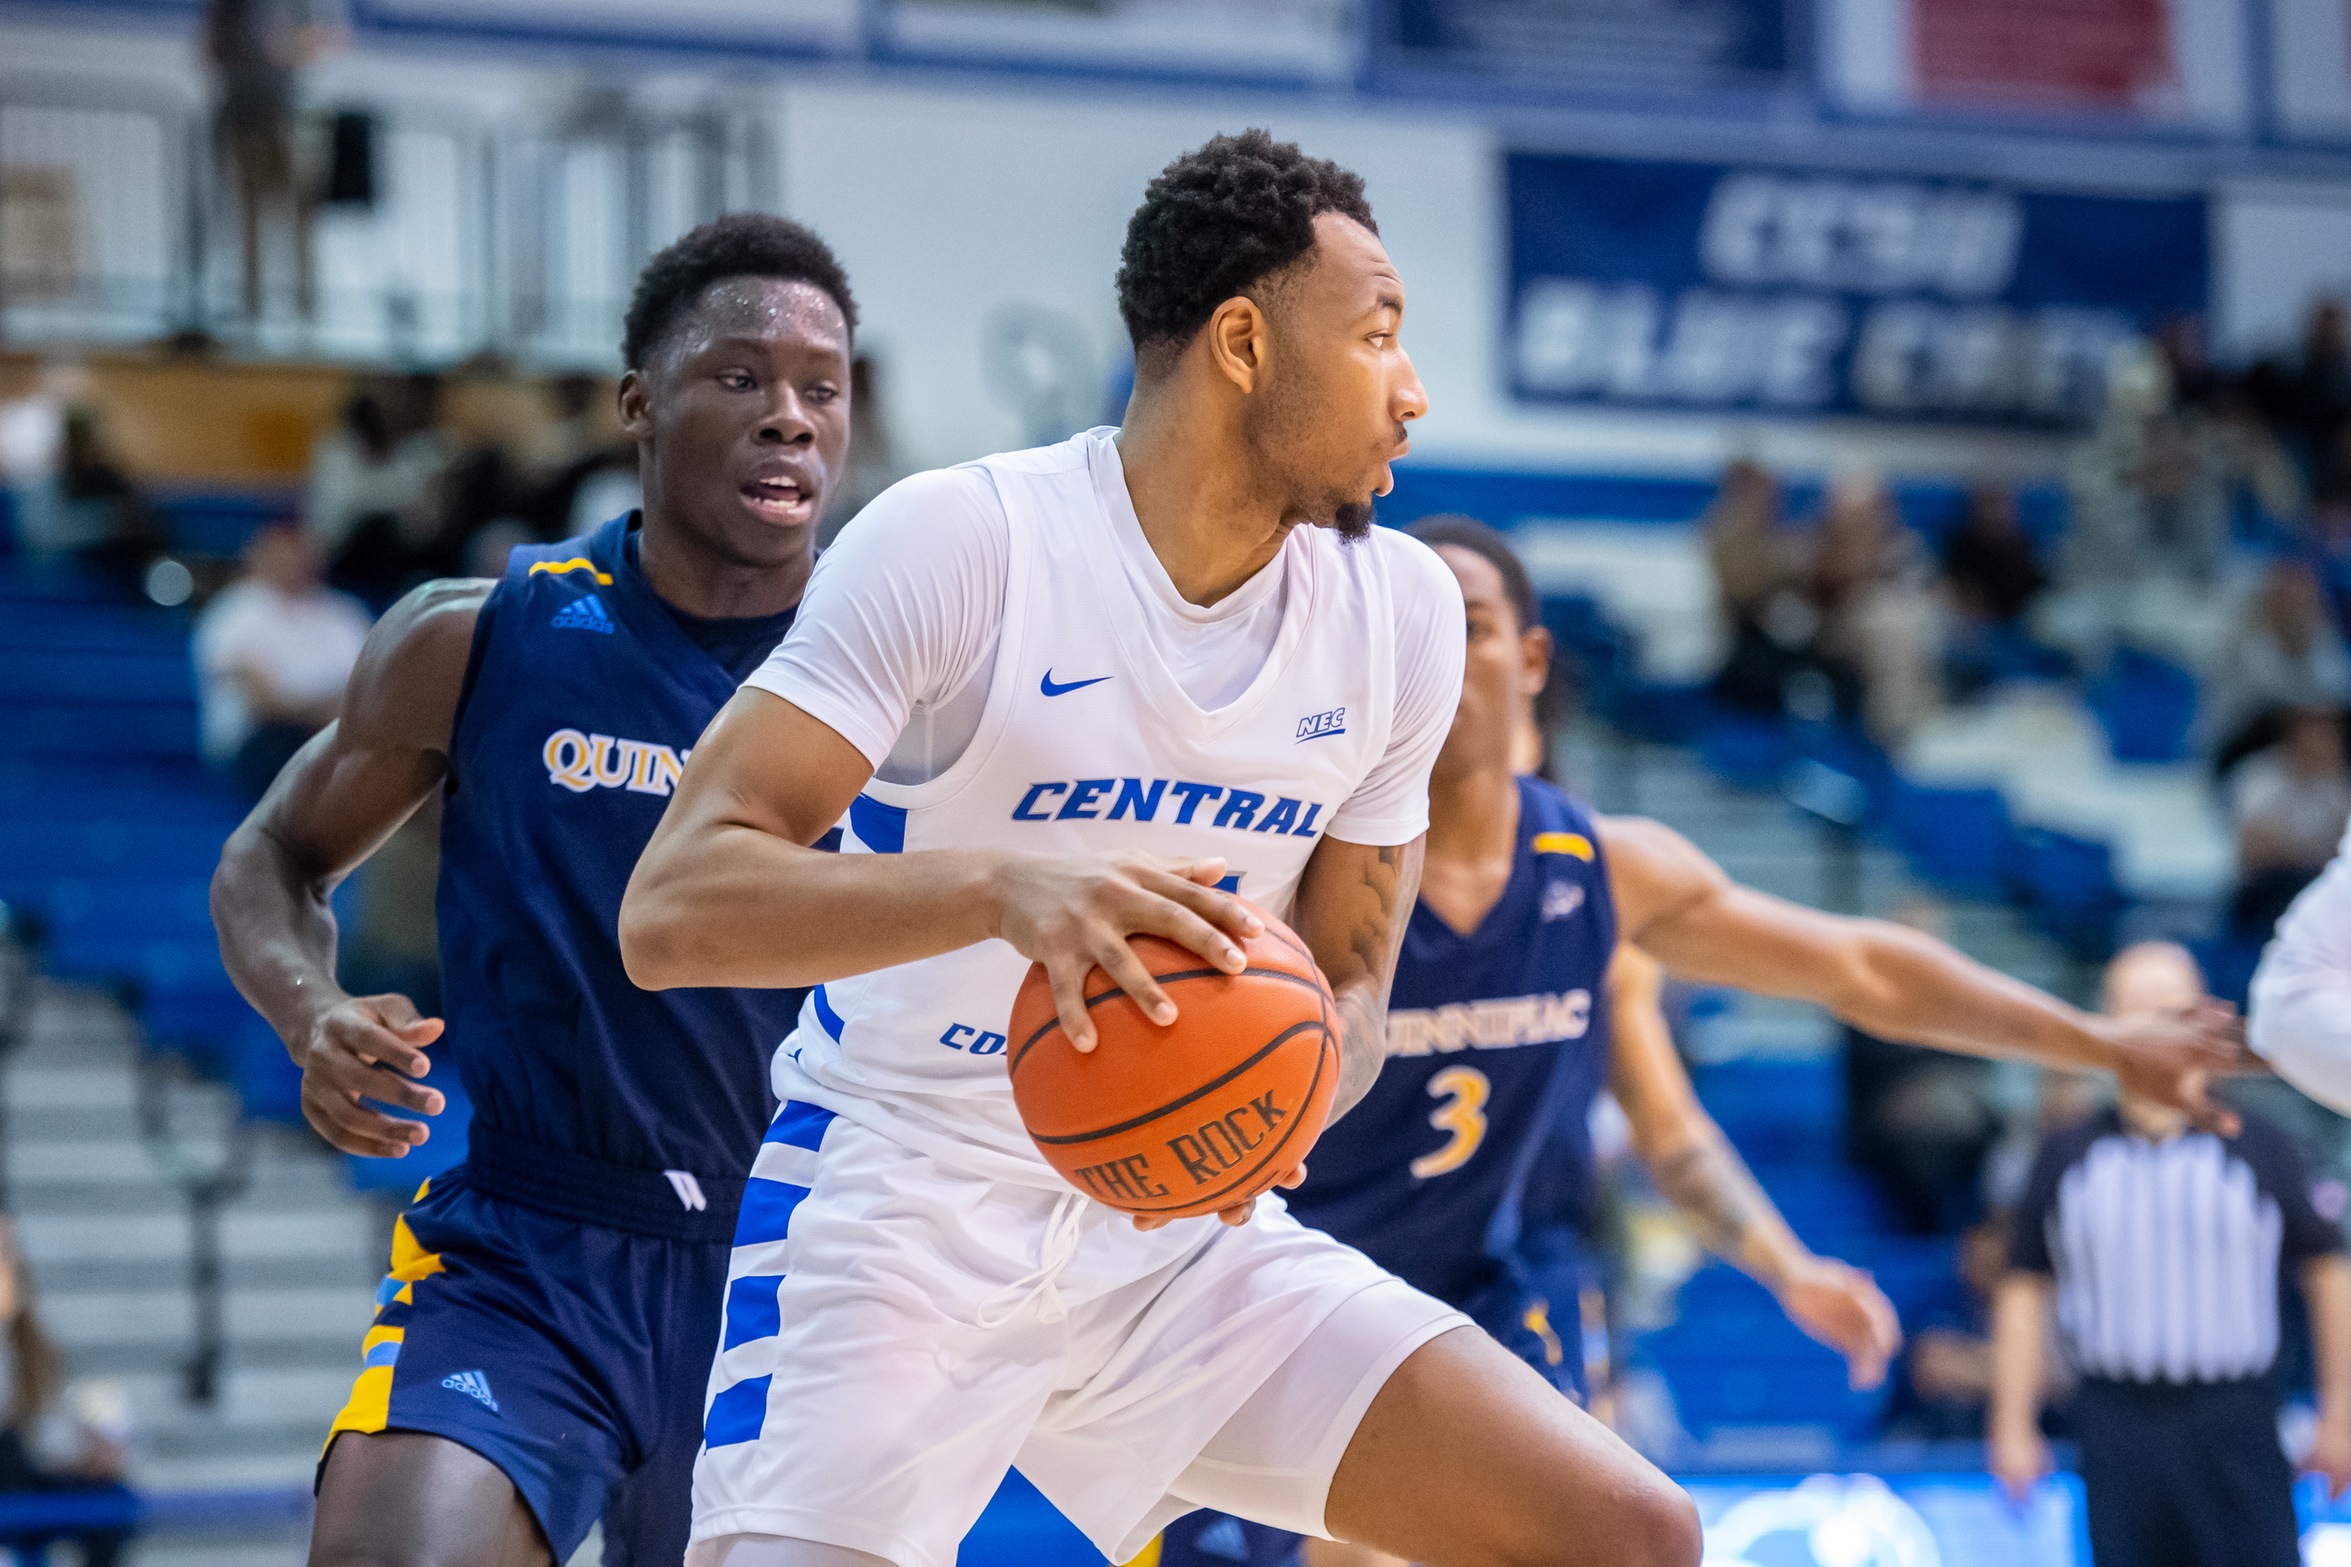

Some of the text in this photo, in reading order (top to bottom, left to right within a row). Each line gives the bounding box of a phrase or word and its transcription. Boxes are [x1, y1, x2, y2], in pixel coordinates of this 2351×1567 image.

[551, 614, 615, 635] adidas
[1296, 707, 1346, 738] NEC
[1011, 777, 1324, 838] CENTRAL
[939, 1022, 1008, 1056] CO
[1409, 1064, 1491, 1179] 3
[1073, 1152, 1170, 1200] THE
[1166, 1089, 1287, 1185] ROCK
[441, 1379, 499, 1413] adidas
